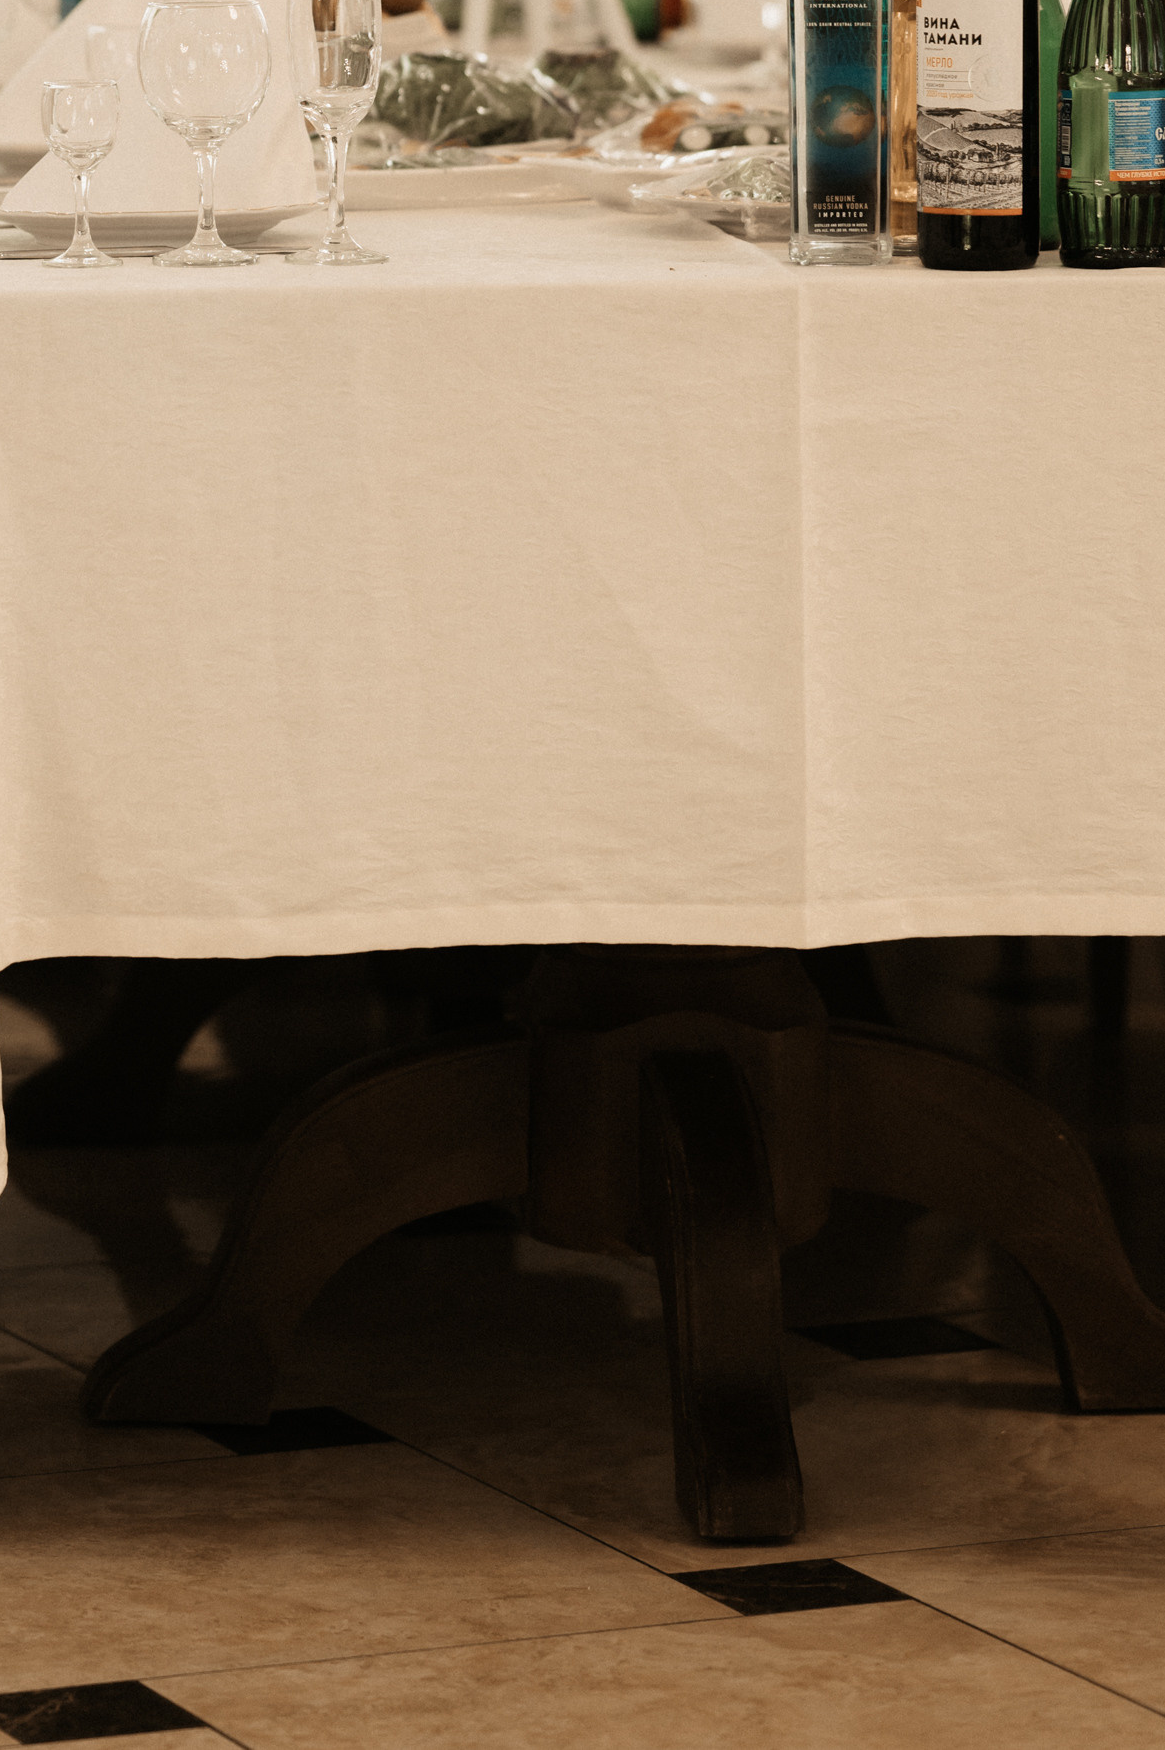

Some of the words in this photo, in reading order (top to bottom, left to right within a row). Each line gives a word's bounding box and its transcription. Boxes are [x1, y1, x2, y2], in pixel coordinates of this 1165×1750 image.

[924, 17, 960, 29] ВИНА
[924, 32, 982, 45] ТАМАНИ
[926, 57, 953, 68] МЕРЛО
